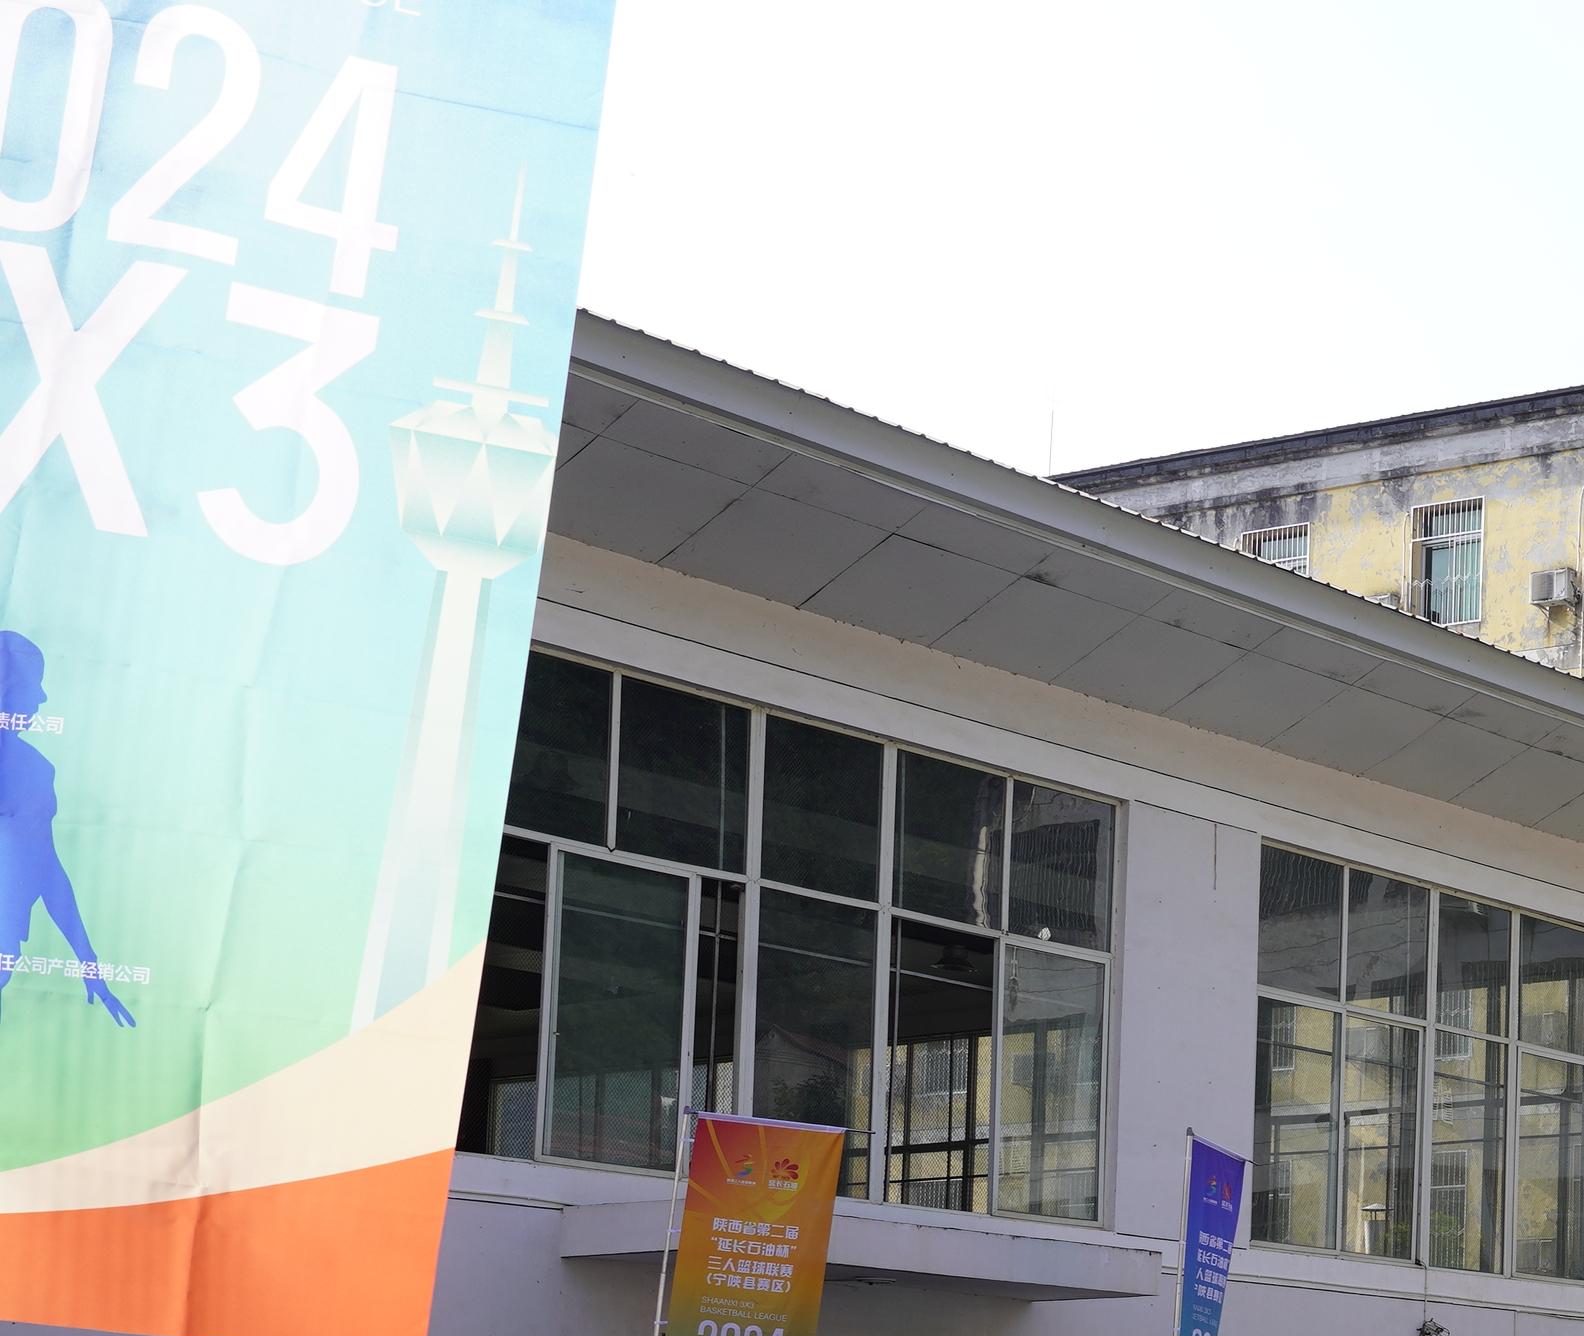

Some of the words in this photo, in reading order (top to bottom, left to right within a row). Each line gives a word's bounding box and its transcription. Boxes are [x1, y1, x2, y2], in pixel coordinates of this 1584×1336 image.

[712, 1217, 800, 1240] 陕西省第二届
[710, 1237, 797, 1258] “延长石油杯”
[707, 1255, 794, 1278] 三人篮球联赛
[702, 1296, 738, 1307] SHAANXI
[700, 1306, 753, 1318] BASKETBALL
[754, 1311, 787, 1322] LEAGUE
